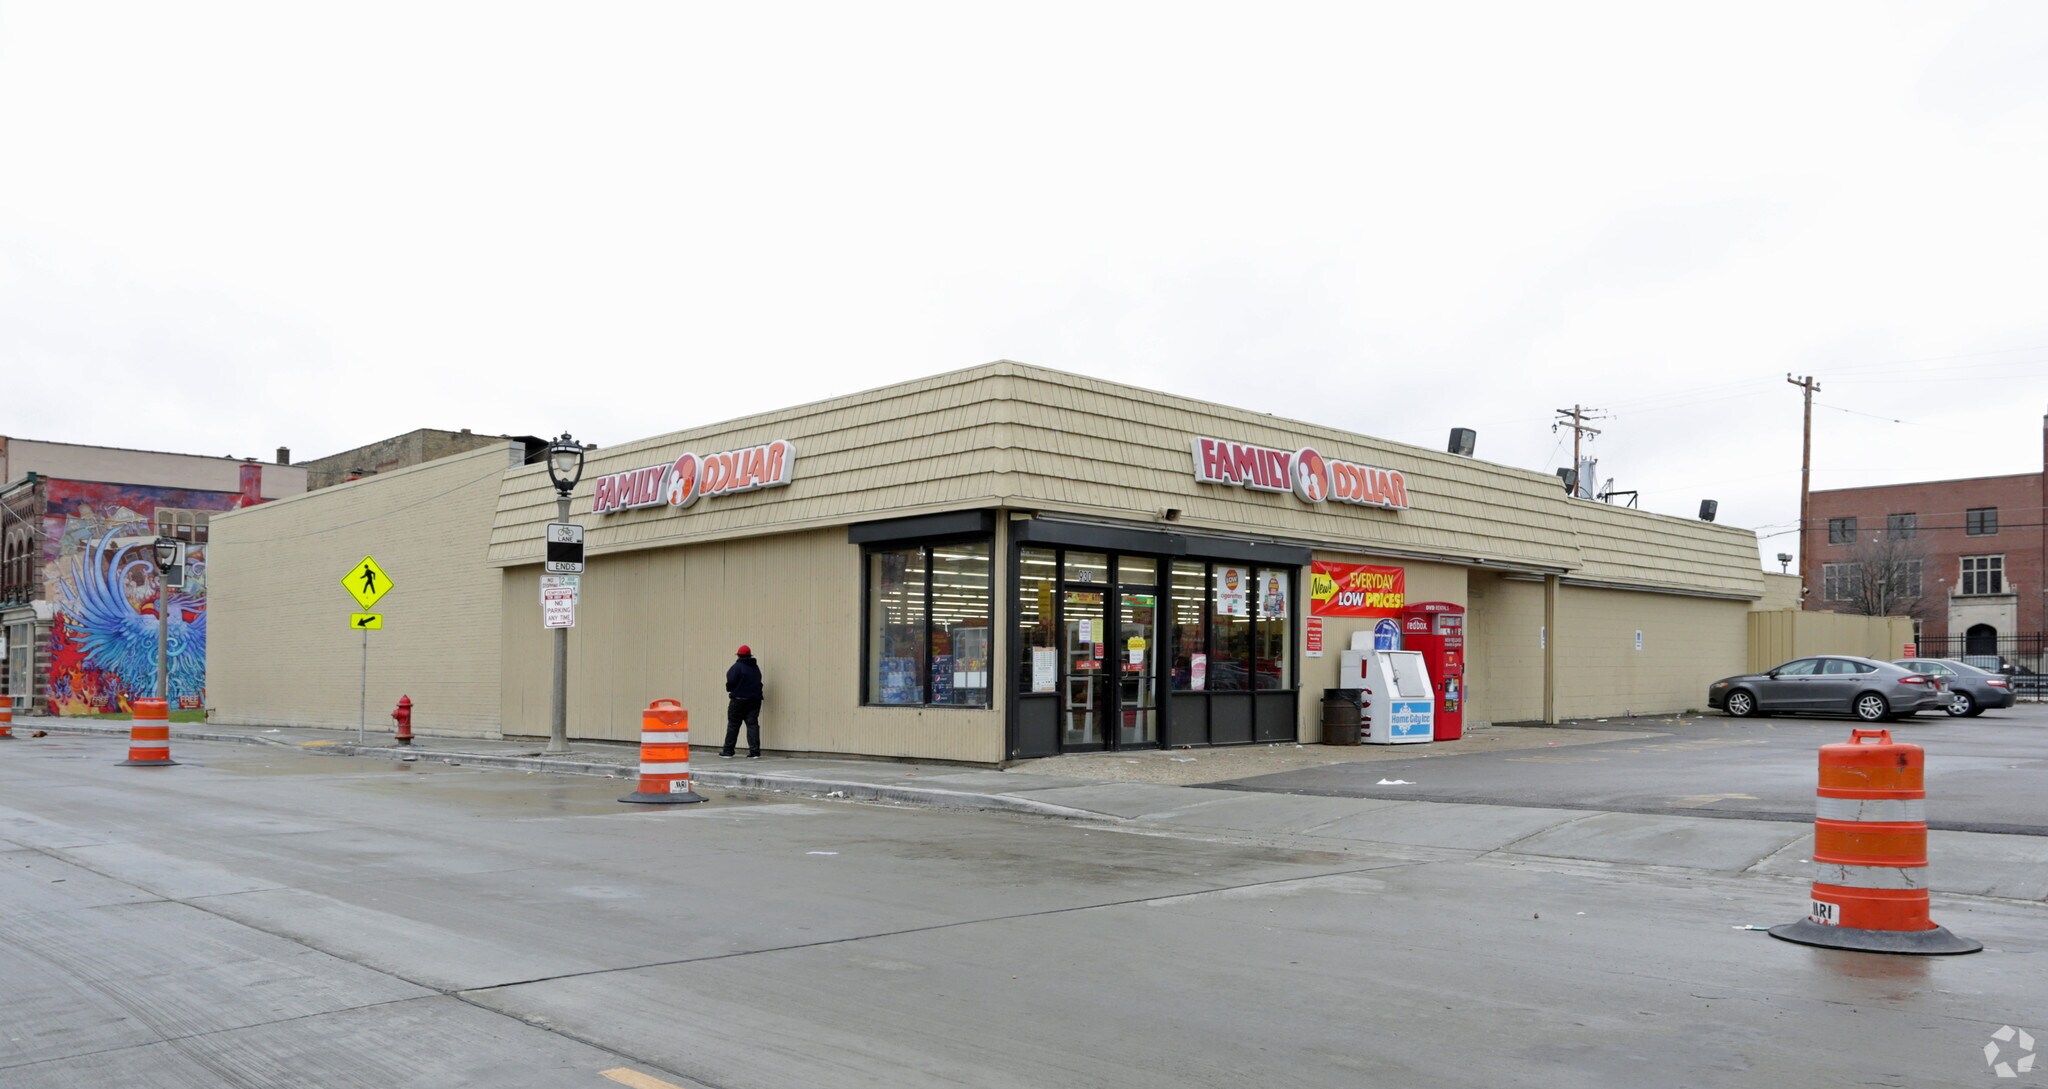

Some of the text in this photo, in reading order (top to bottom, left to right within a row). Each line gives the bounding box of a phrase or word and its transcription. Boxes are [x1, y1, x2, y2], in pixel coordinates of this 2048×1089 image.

[592, 442, 786, 512] FAMILY DOLLAR
[1200, 439, 1408, 508] FAMILY DOLLAR
[555, 562, 576, 571] ENDS
[1079, 570, 1093, 582] 930
[1349, 572, 1394, 589] EVERYDAY
[1311, 577, 1332, 596] New!
[1338, 591, 1404, 609] LOW PRICES!
[1406, 620, 1427, 630] redbox
[180, 695, 200, 703] FREE
[1391, 714, 1430, 724] Home City Ice
